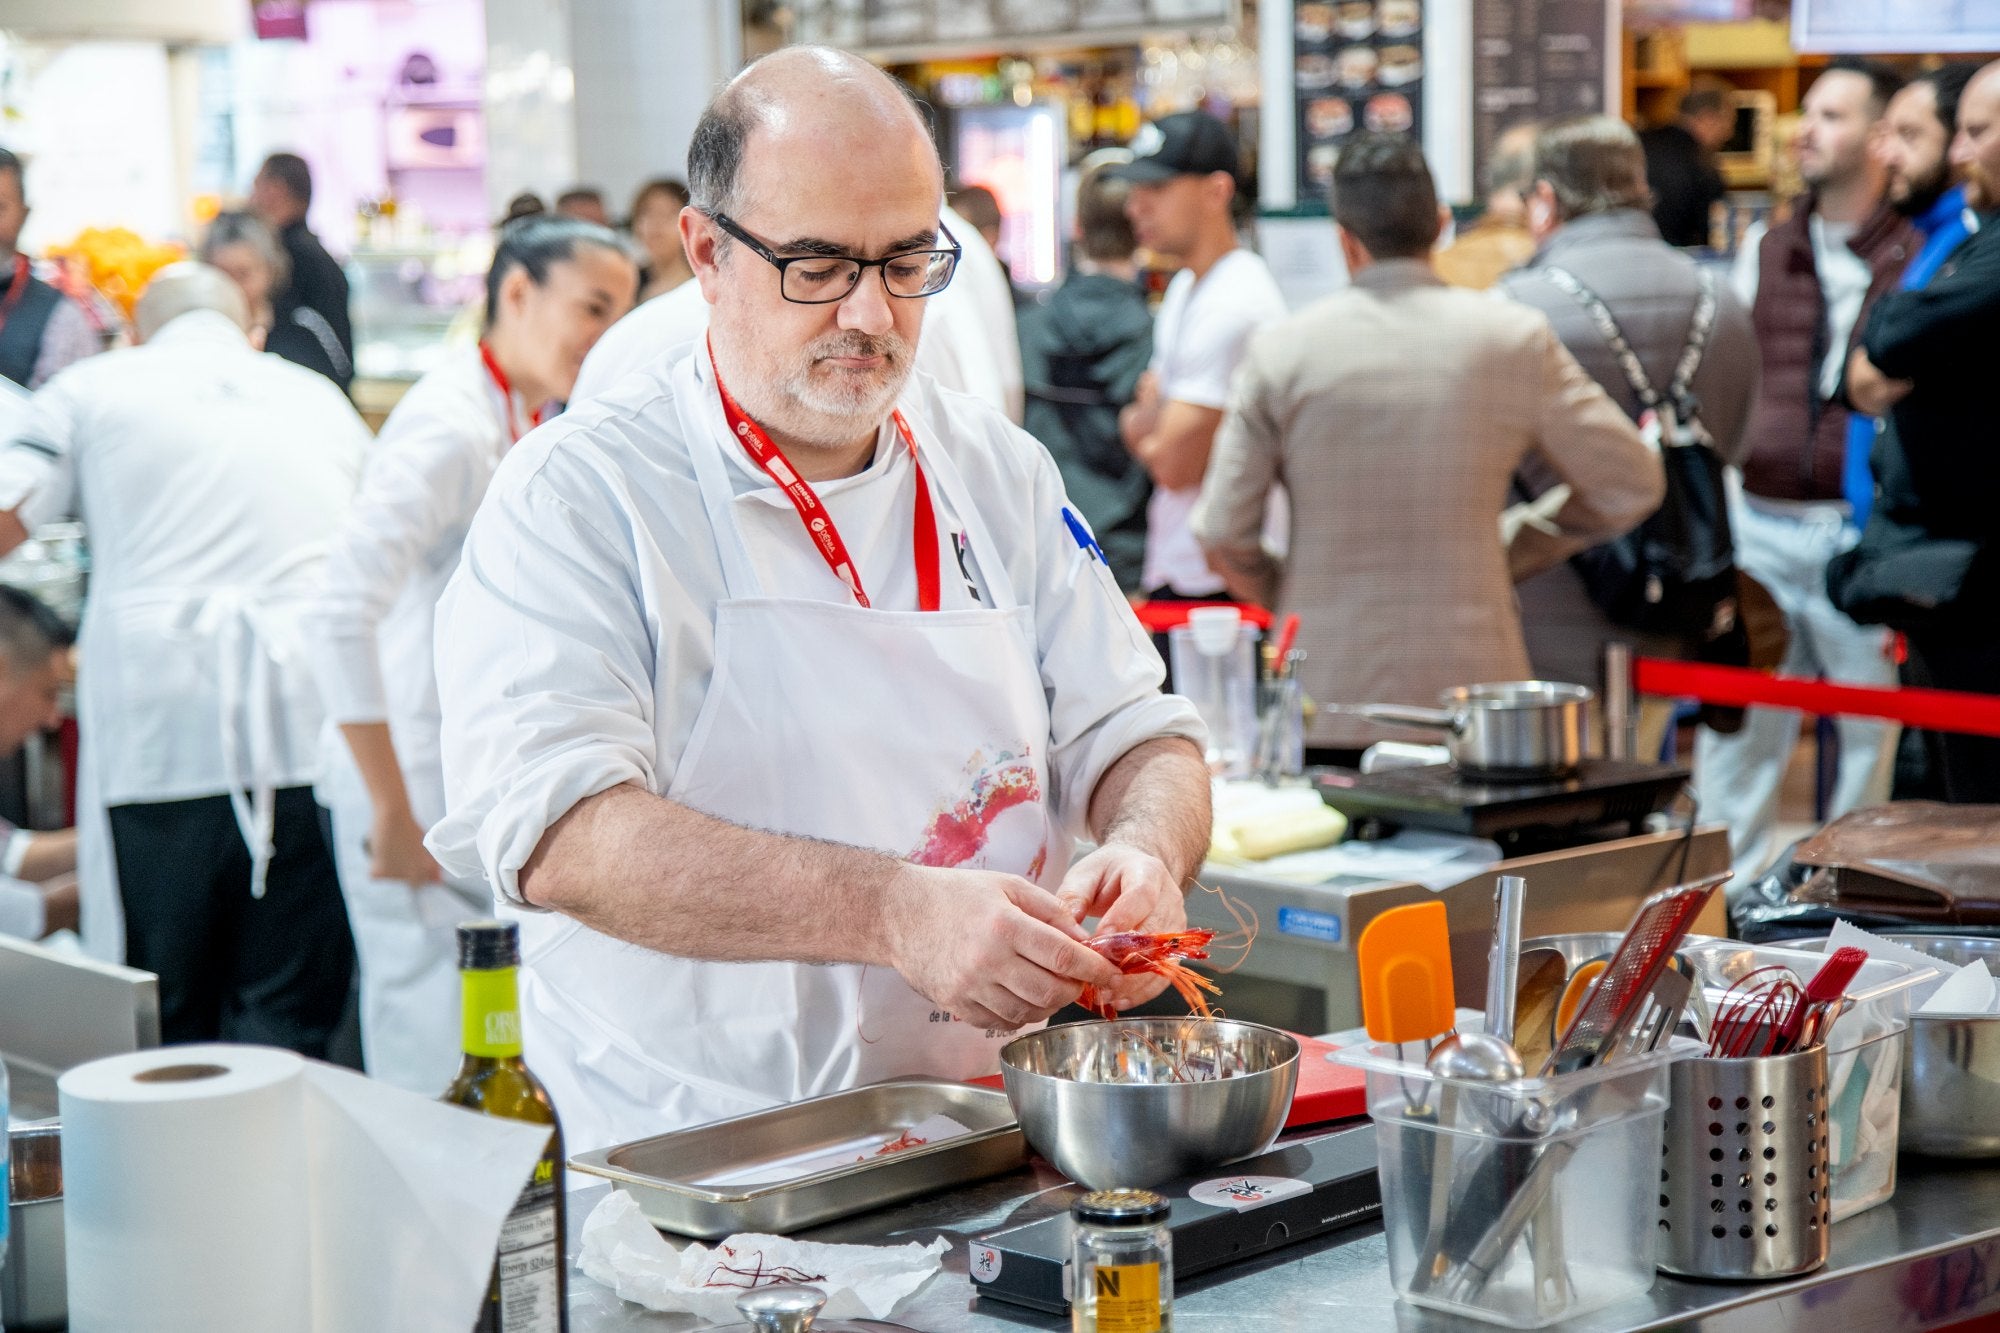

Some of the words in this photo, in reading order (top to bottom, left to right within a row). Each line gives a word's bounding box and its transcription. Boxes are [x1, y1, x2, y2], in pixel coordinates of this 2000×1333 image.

[794, 482, 816, 509] unesco
[820, 529, 836, 553] DÉNIA
[929, 1010, 940, 1022] de
[942, 1010, 950, 1022] la
[1096, 1270, 1120, 1297] N
